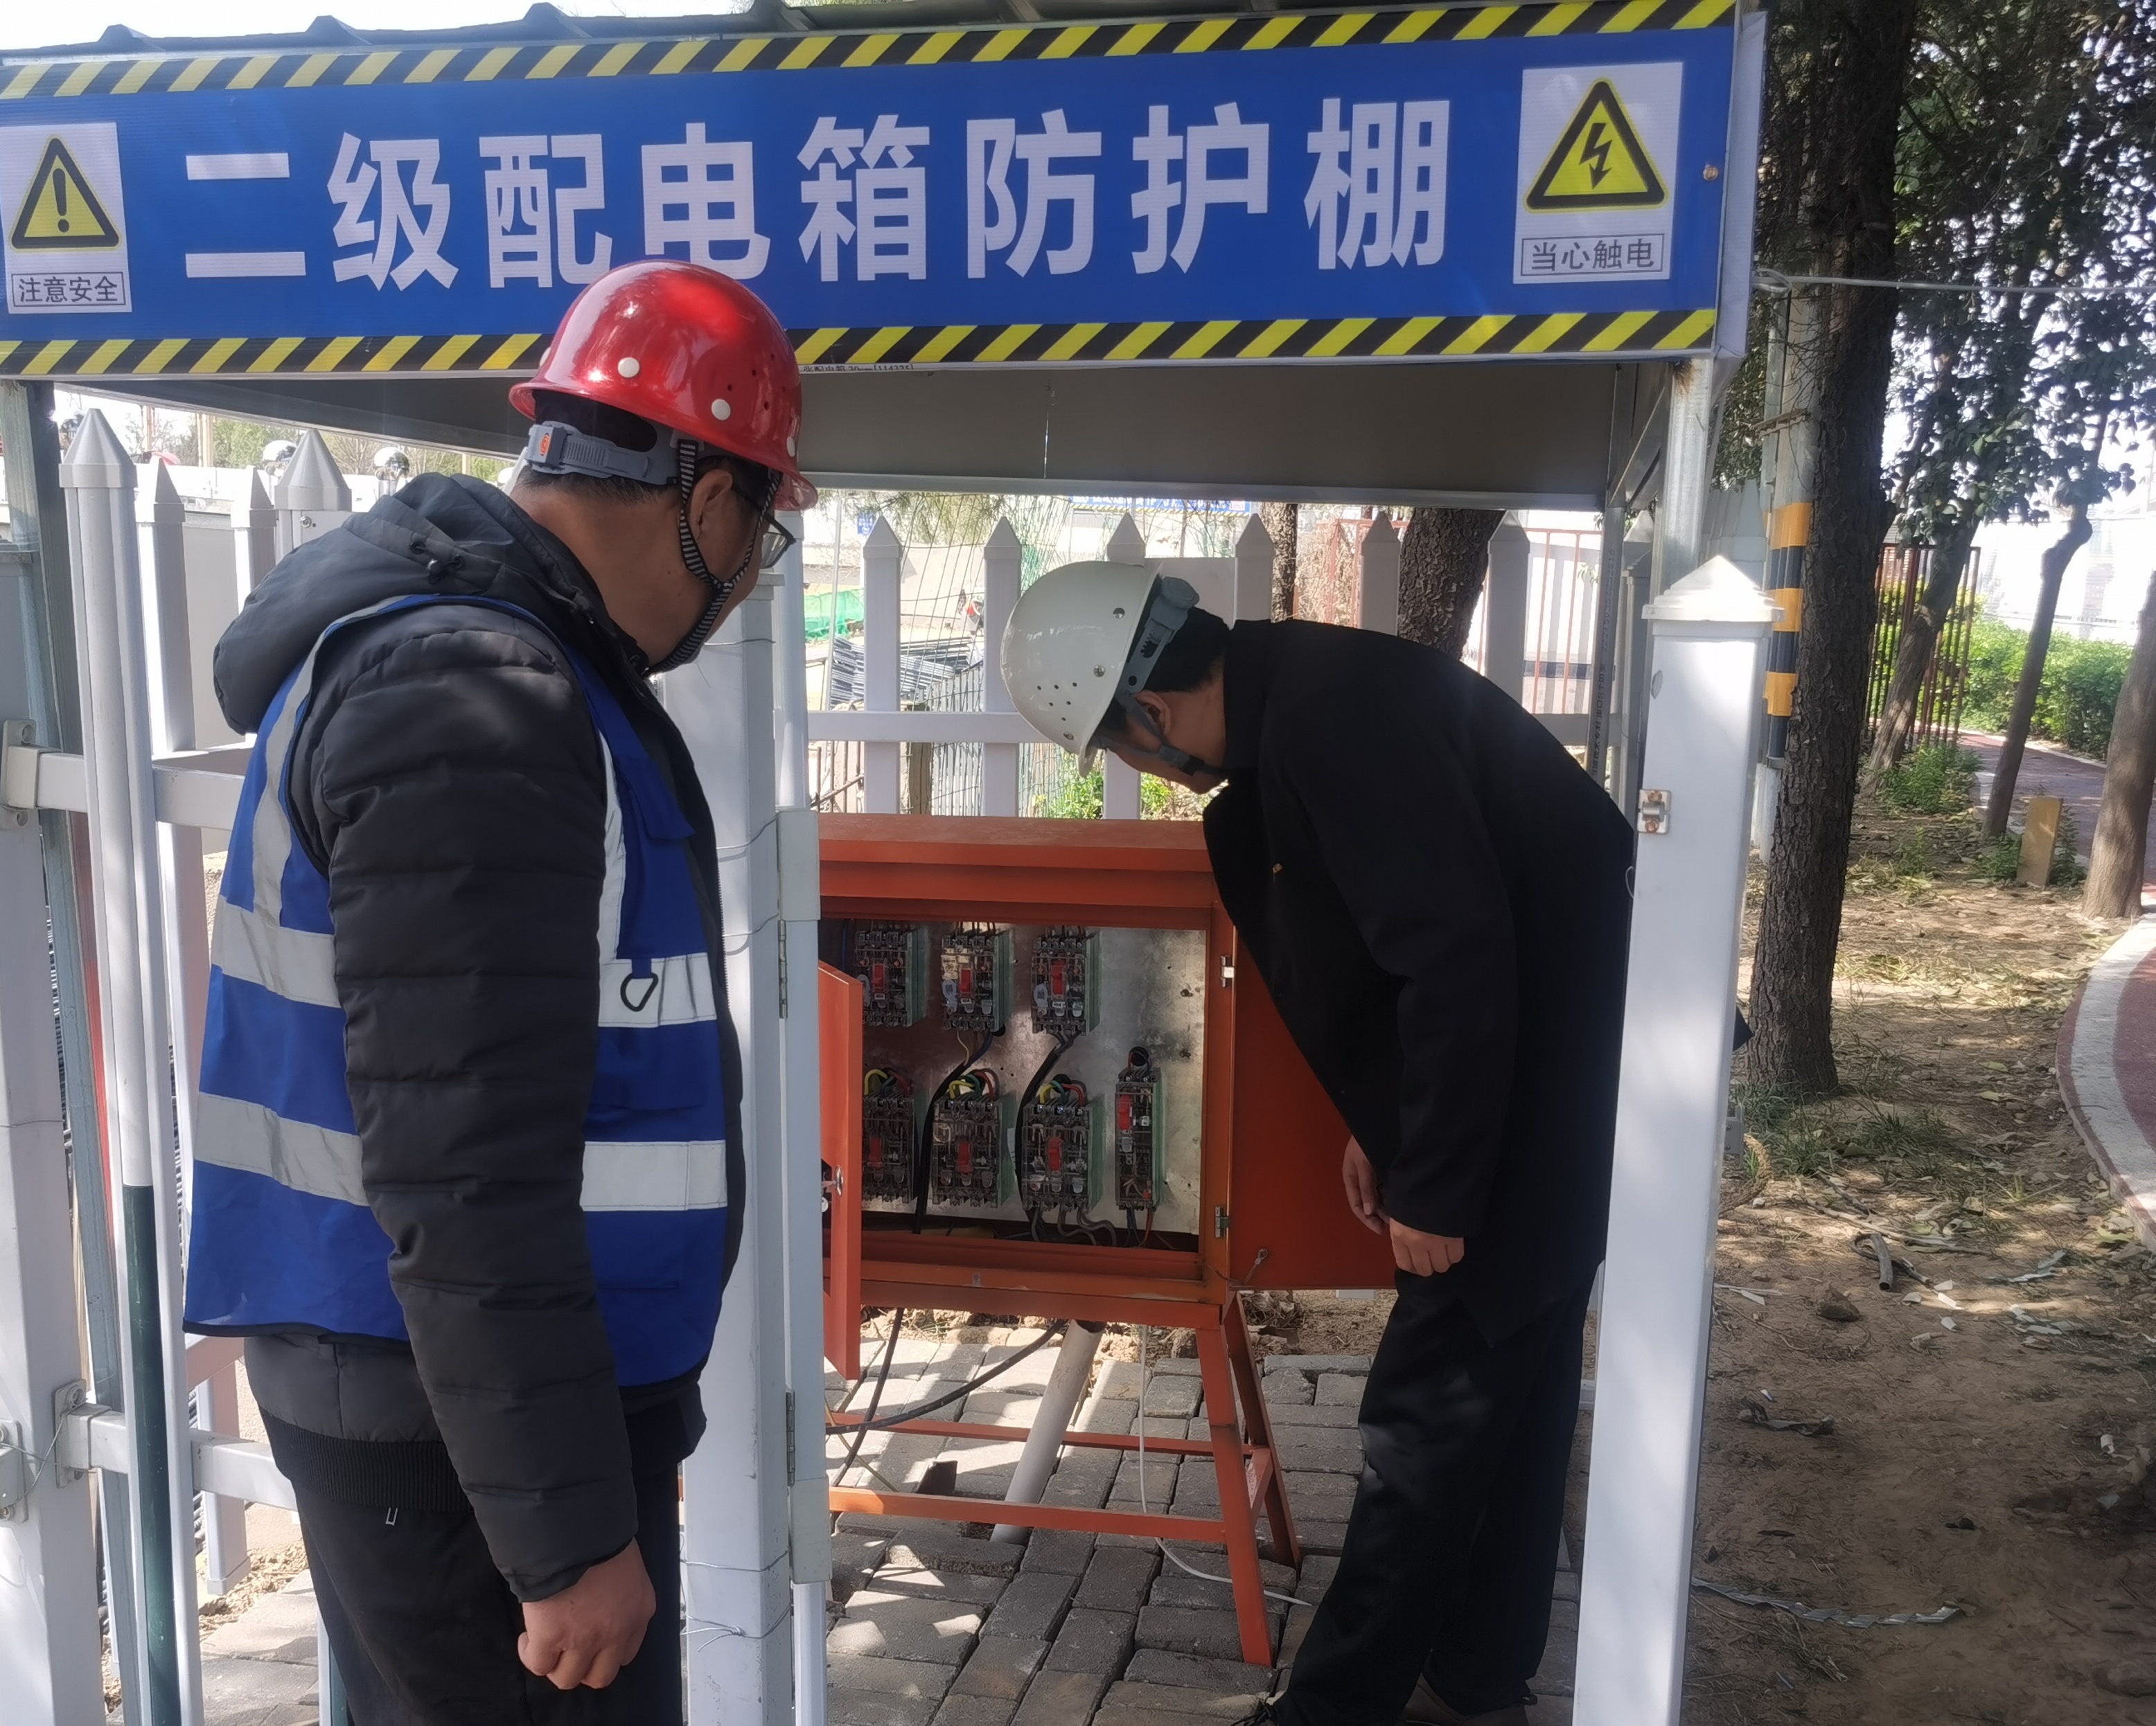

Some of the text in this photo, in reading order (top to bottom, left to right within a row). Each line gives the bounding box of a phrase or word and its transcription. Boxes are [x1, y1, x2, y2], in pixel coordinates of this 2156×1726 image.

[185, 98, 1450, 291] 二级配电箱防护棚
[1531, 238, 1654, 272] 当心触电
[19, 276, 118, 303] 注意安全
